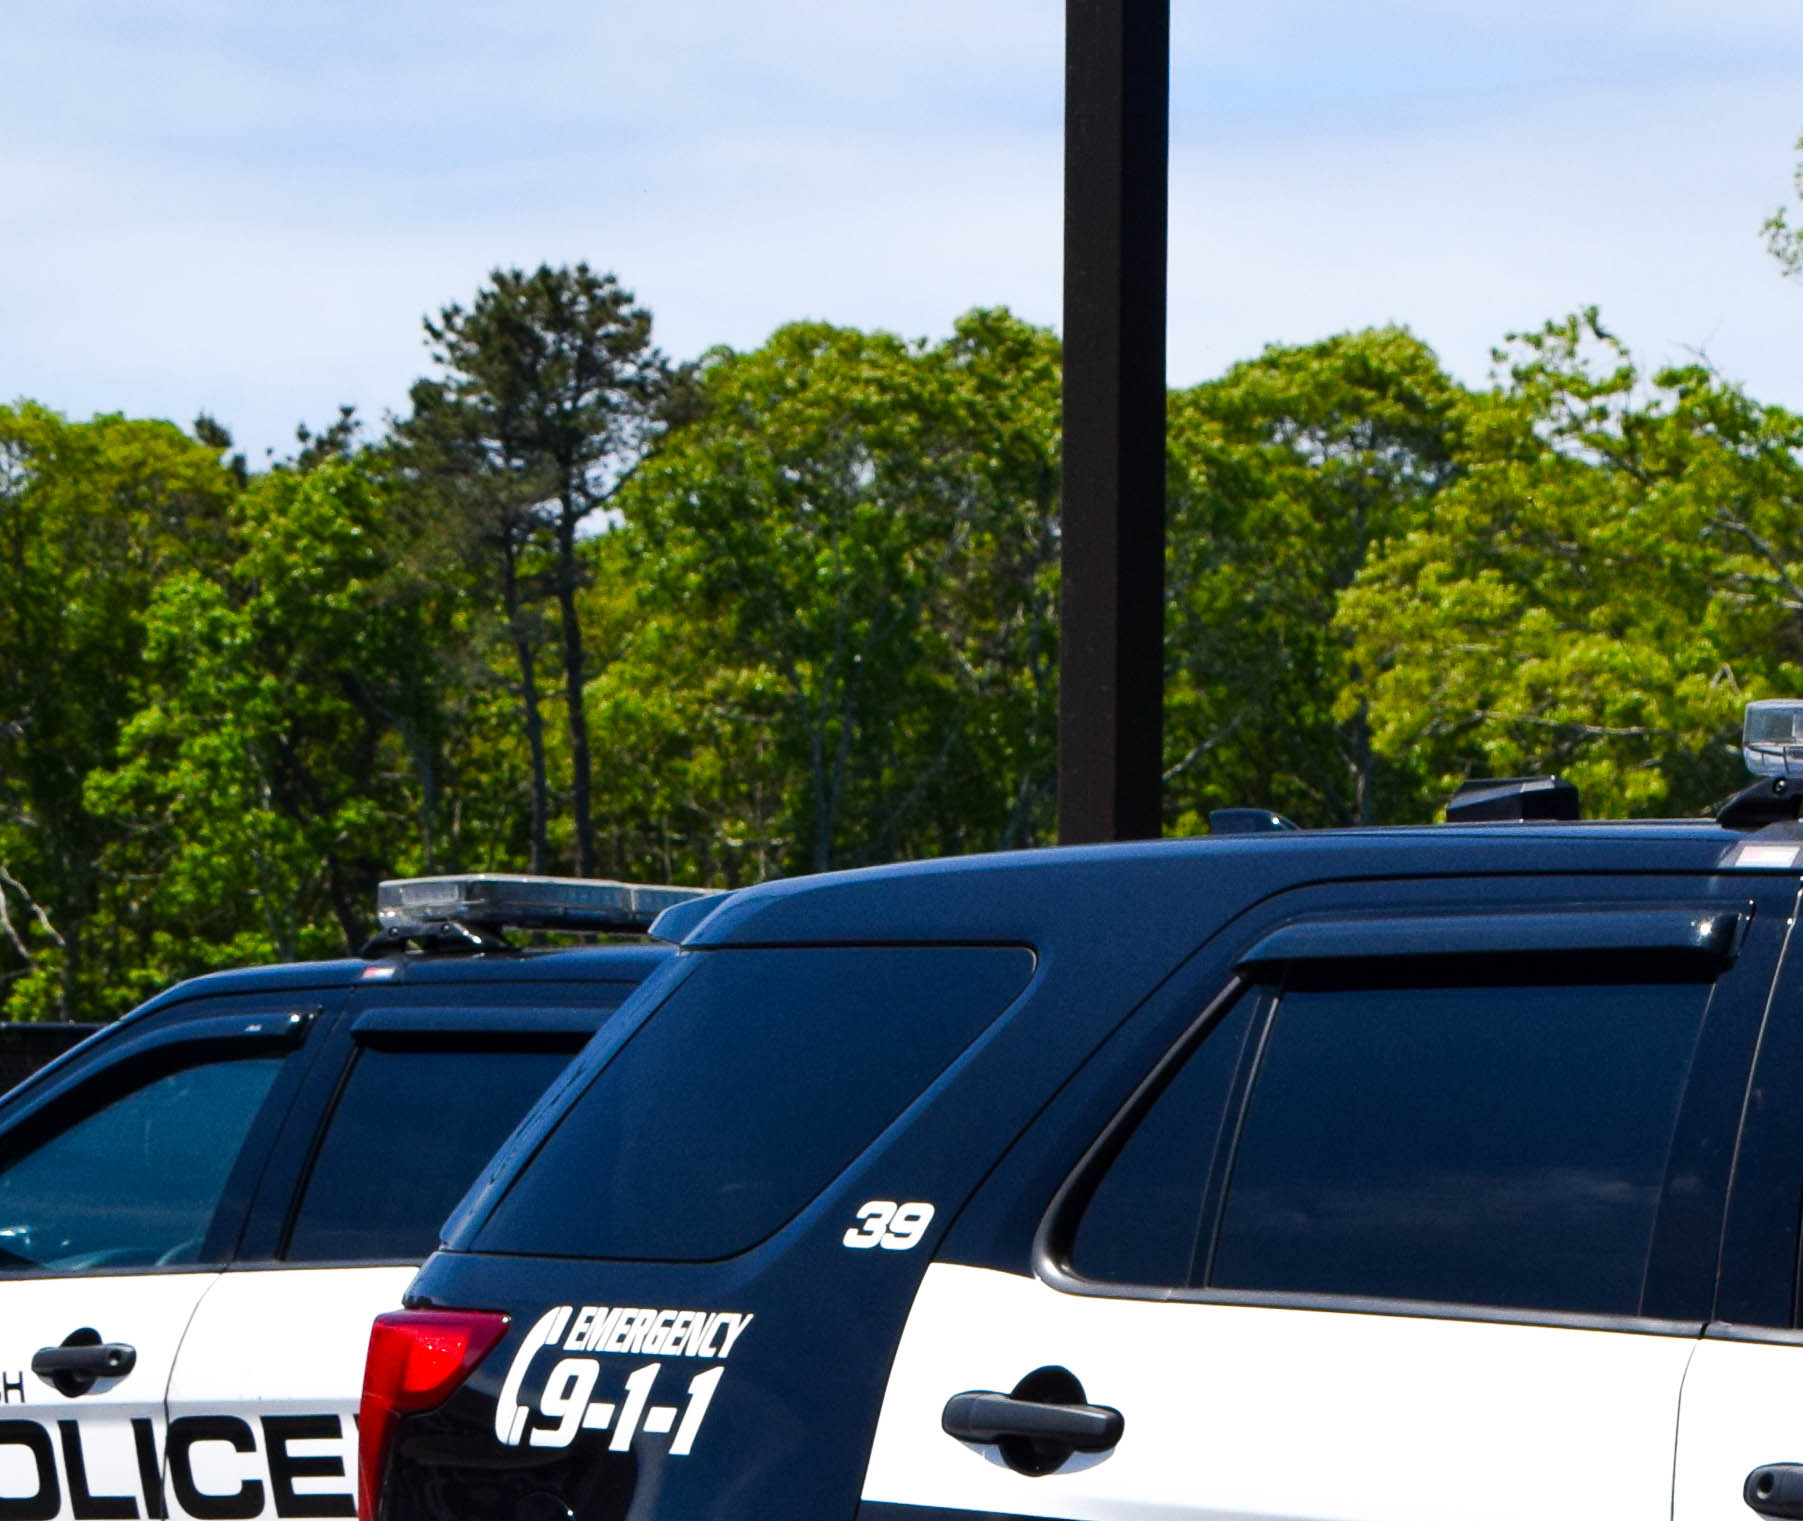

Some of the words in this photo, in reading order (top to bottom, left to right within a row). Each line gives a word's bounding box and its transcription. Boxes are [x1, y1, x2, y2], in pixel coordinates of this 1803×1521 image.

[843, 1200, 935, 1251] 39
[563, 1306, 754, 1359] EMERGENCY
[529, 1358, 725, 1456] 9-1-1
